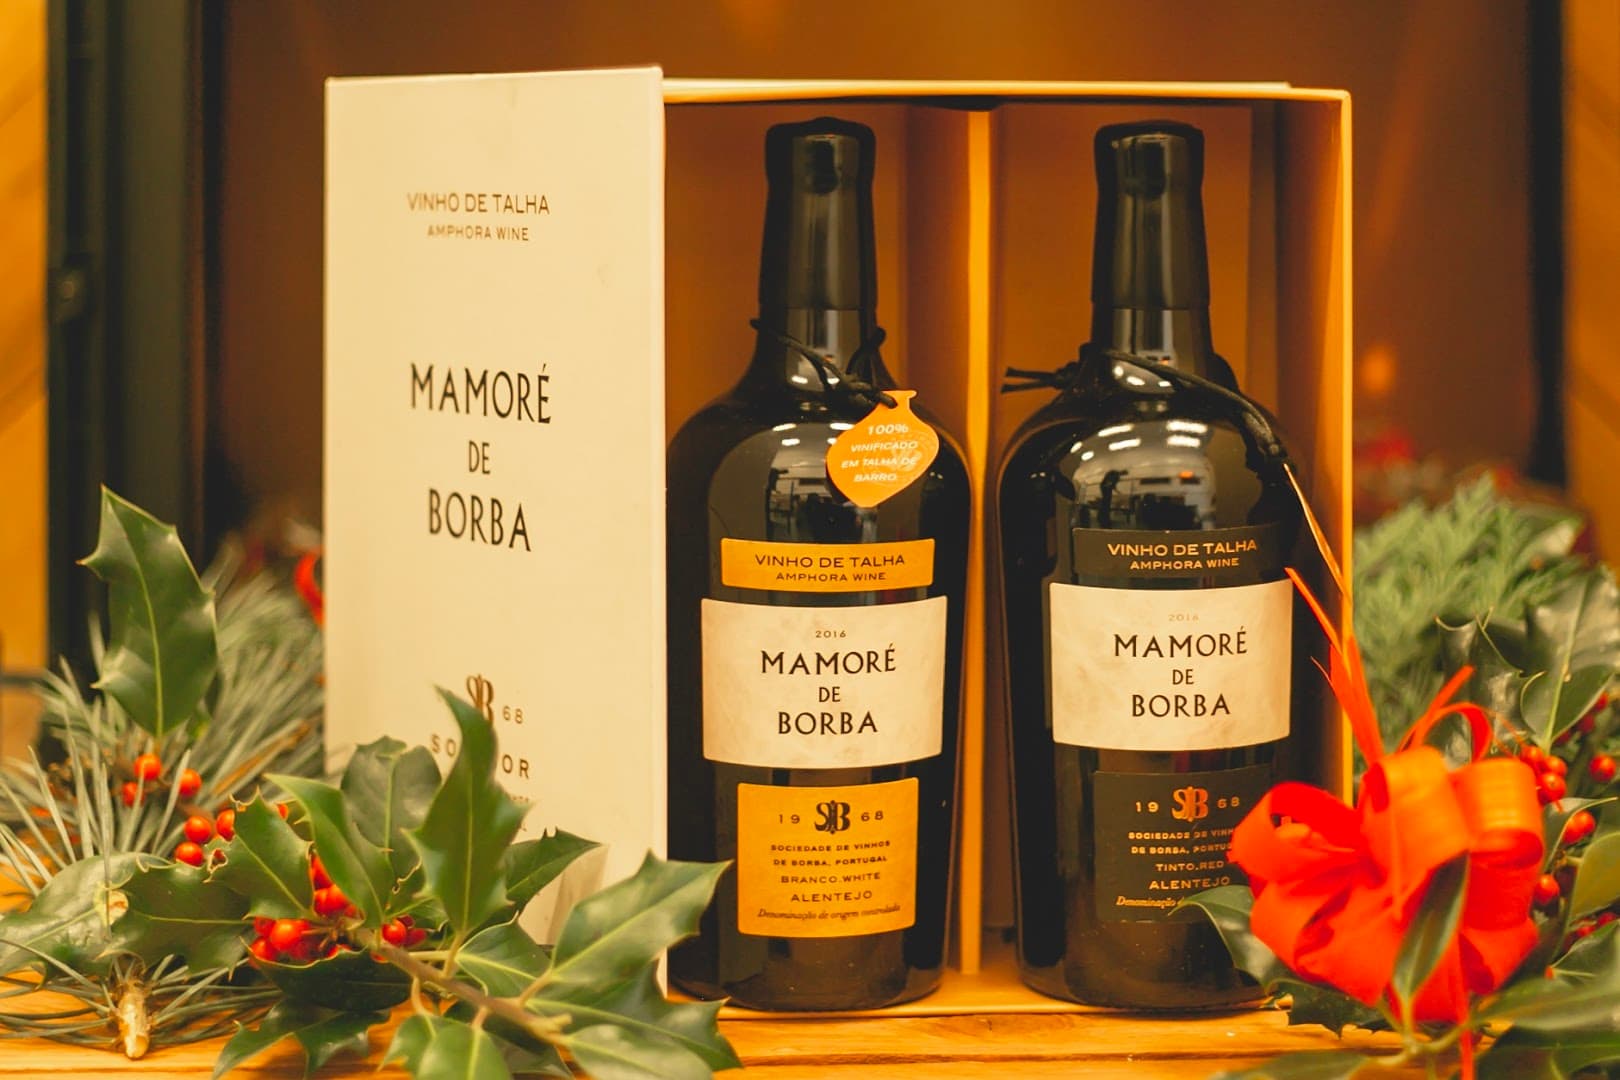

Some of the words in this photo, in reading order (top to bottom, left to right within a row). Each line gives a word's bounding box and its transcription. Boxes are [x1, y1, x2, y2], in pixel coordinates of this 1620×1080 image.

[408, 192, 459, 212] VINHO
[465, 193, 488, 213] DE
[492, 194, 550, 215] TALHA
[427, 225, 492, 240] AMPHORA
[496, 226, 529, 242] WINE
[410, 362, 552, 424] MAMORÉ
[867, 424, 909, 435] 100%
[850, 441, 919, 453] VINIFICADO
[468, 440, 491, 474] DE
[841, 460, 859, 468] EM
[863, 458, 898, 467] TALHA
[900, 456, 917, 465] DE
[428, 487, 532, 552] BORBA
[1107, 543, 1168, 556] VINHO
[1173, 544, 1199, 556] DE
[1202, 539, 1257, 555] TALHA
[755, 555, 813, 568] VINHO
[819, 558, 844, 568] DE
[849, 555, 905, 567] TALHA
[1130, 560, 1203, 569] AMPHORA
[1206, 558, 1240, 568] WINE
[776, 573, 847, 582] AMPHORA
[852, 572, 886, 581] WINE
[815, 630, 847, 638] 2016
[1113, 626, 1248, 658] MAMORÉ
[761, 643, 896, 675] MAMORÉ
[1172, 669, 1194, 685] DE
[819, 687, 841, 702] DE
[1132, 693, 1231, 718] BORBA
[503, 705, 523, 724] 68
[778, 711, 878, 735] BORBA
[430, 733, 529, 779] SOOR
[1135, 802, 1159, 812] 19
[1217, 797, 1241, 808] 68
[779, 814, 800, 824] 19
[861, 811, 884, 822] 68
[1128, 832, 1190, 840] SOCIEDADE
[854, 840, 891, 850] VINHOS
[1131, 846, 1146, 854] DE
[1149, 846, 1190, 854] BORBA,
[836, 856, 887, 865] PORTUGAL
[1149, 877, 1231, 890] ALENTEJO
[791, 891, 873, 902] ALENTEJO
[757, 909, 816, 920] Denominação
[818, 911, 829, 919] de
[831, 911, 859, 920] origem
